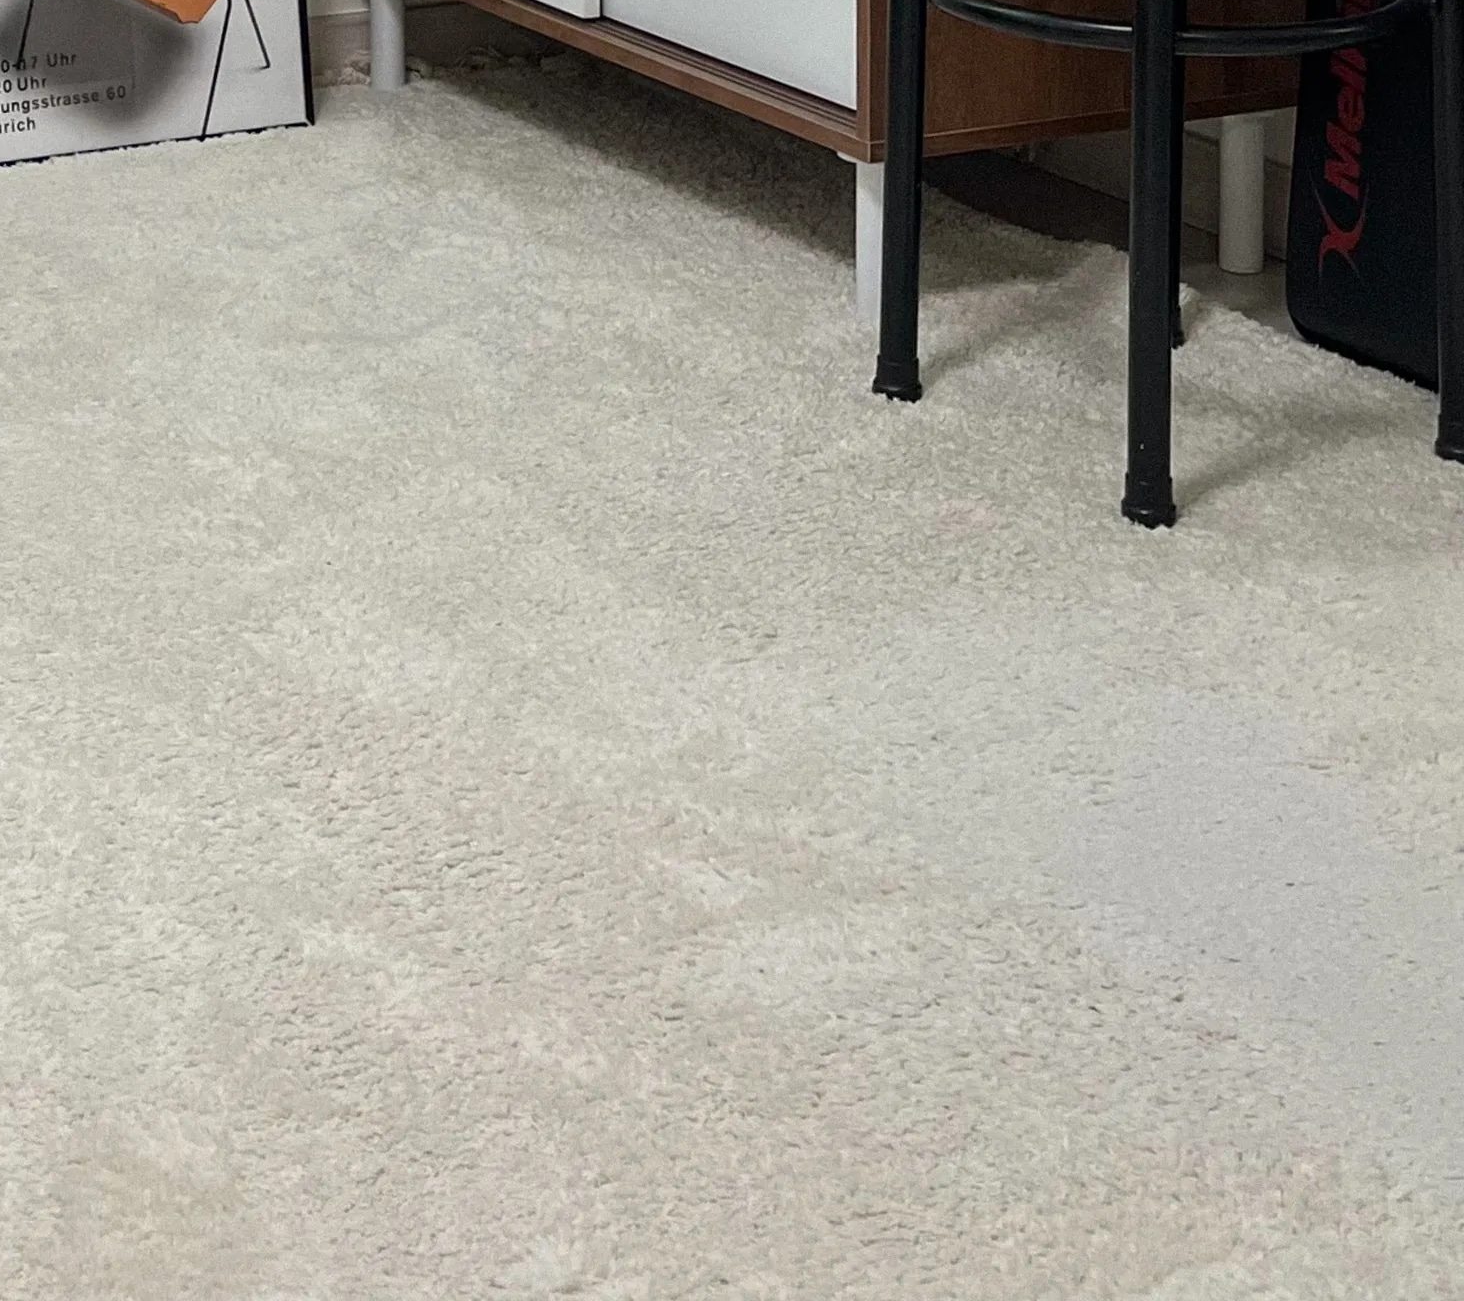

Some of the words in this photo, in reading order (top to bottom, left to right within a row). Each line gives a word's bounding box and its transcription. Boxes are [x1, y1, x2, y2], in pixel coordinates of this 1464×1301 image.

[46, 53, 77, 68] Uhr
[17, 76, 48, 91] Uhr
[106, 85, 127, 101] 60
